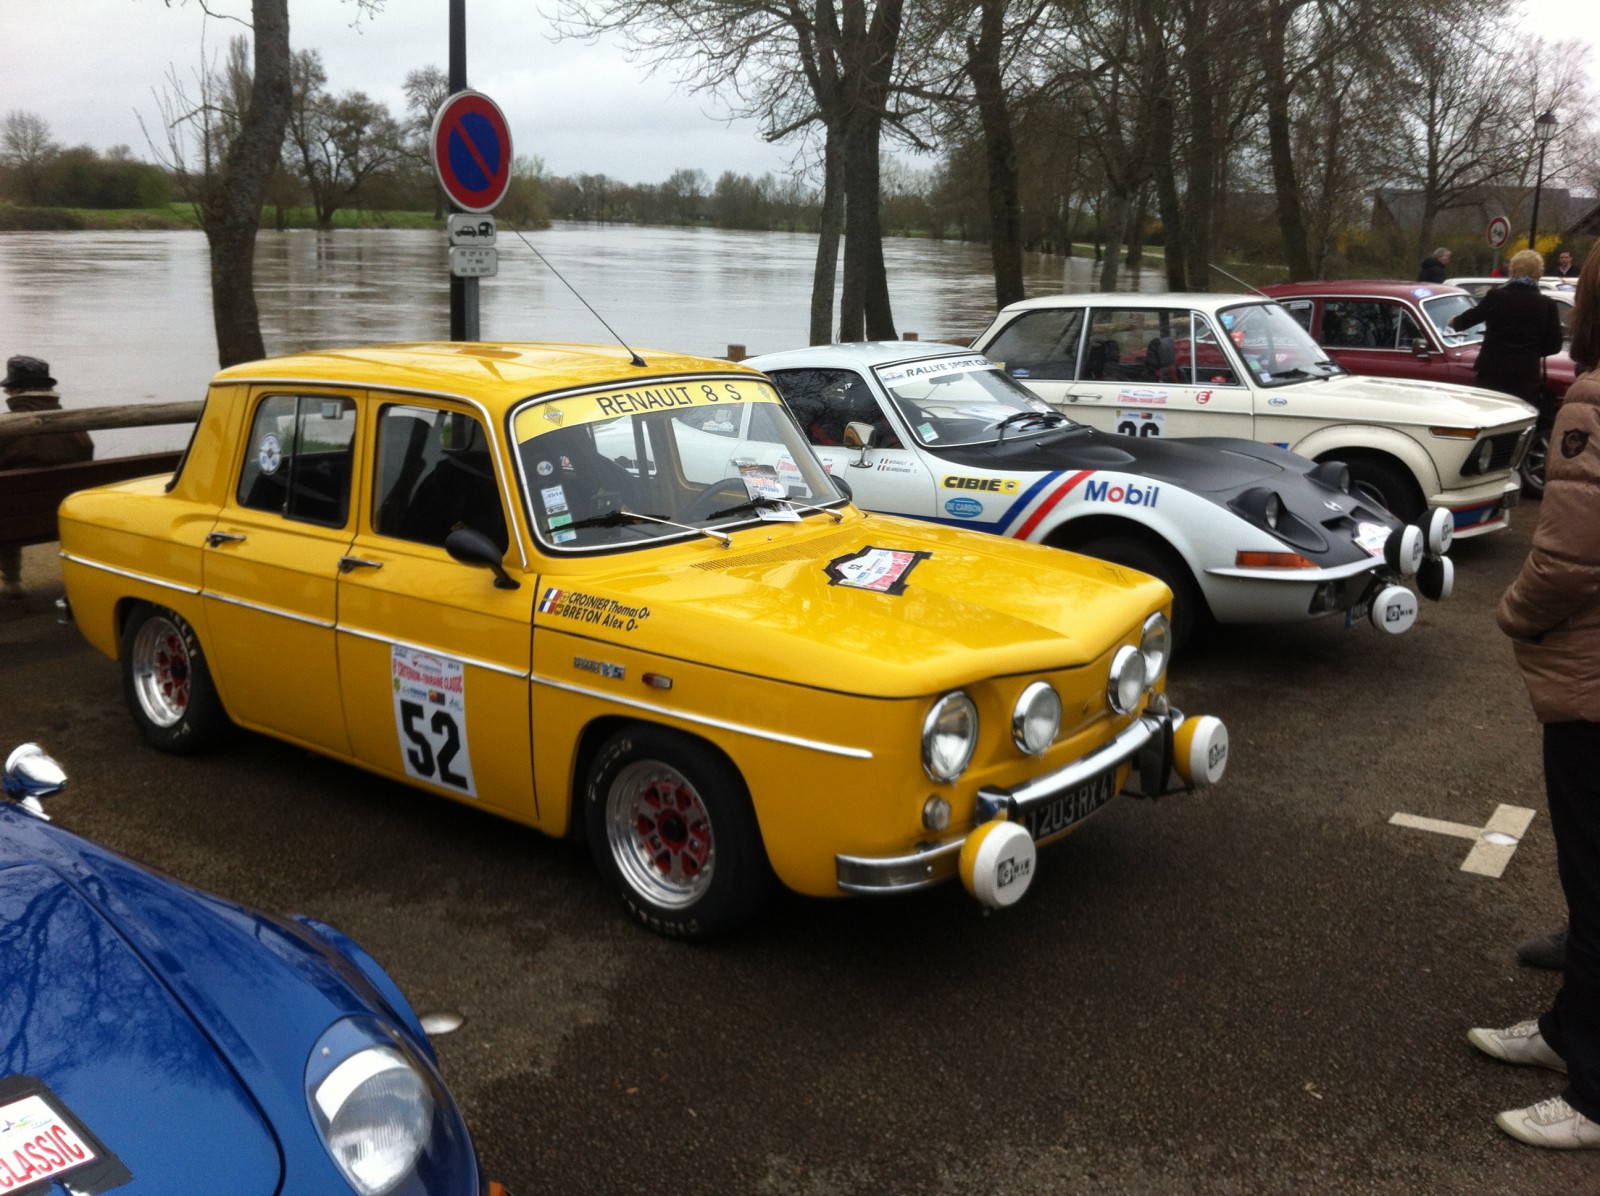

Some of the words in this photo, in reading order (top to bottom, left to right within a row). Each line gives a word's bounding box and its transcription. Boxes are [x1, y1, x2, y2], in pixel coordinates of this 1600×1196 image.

[905, 361, 948, 378] RALLYE
[948, 359, 975, 370] SPORT
[596, 386, 694, 416] RENAULT
[700, 385, 719, 402] 8
[724, 384, 742, 401] S
[1084, 480, 1160, 508] Mobil
[562, 604, 603, 624] BRETON
[602, 613, 625, 630] Alex
[568, 592, 611, 611] CROSNIER
[608, 600, 639, 618] Thomas
[400, 699, 468, 791] 52
[1030, 793, 1075, 839] 1203
[1079, 781, 1097, 818] RX
